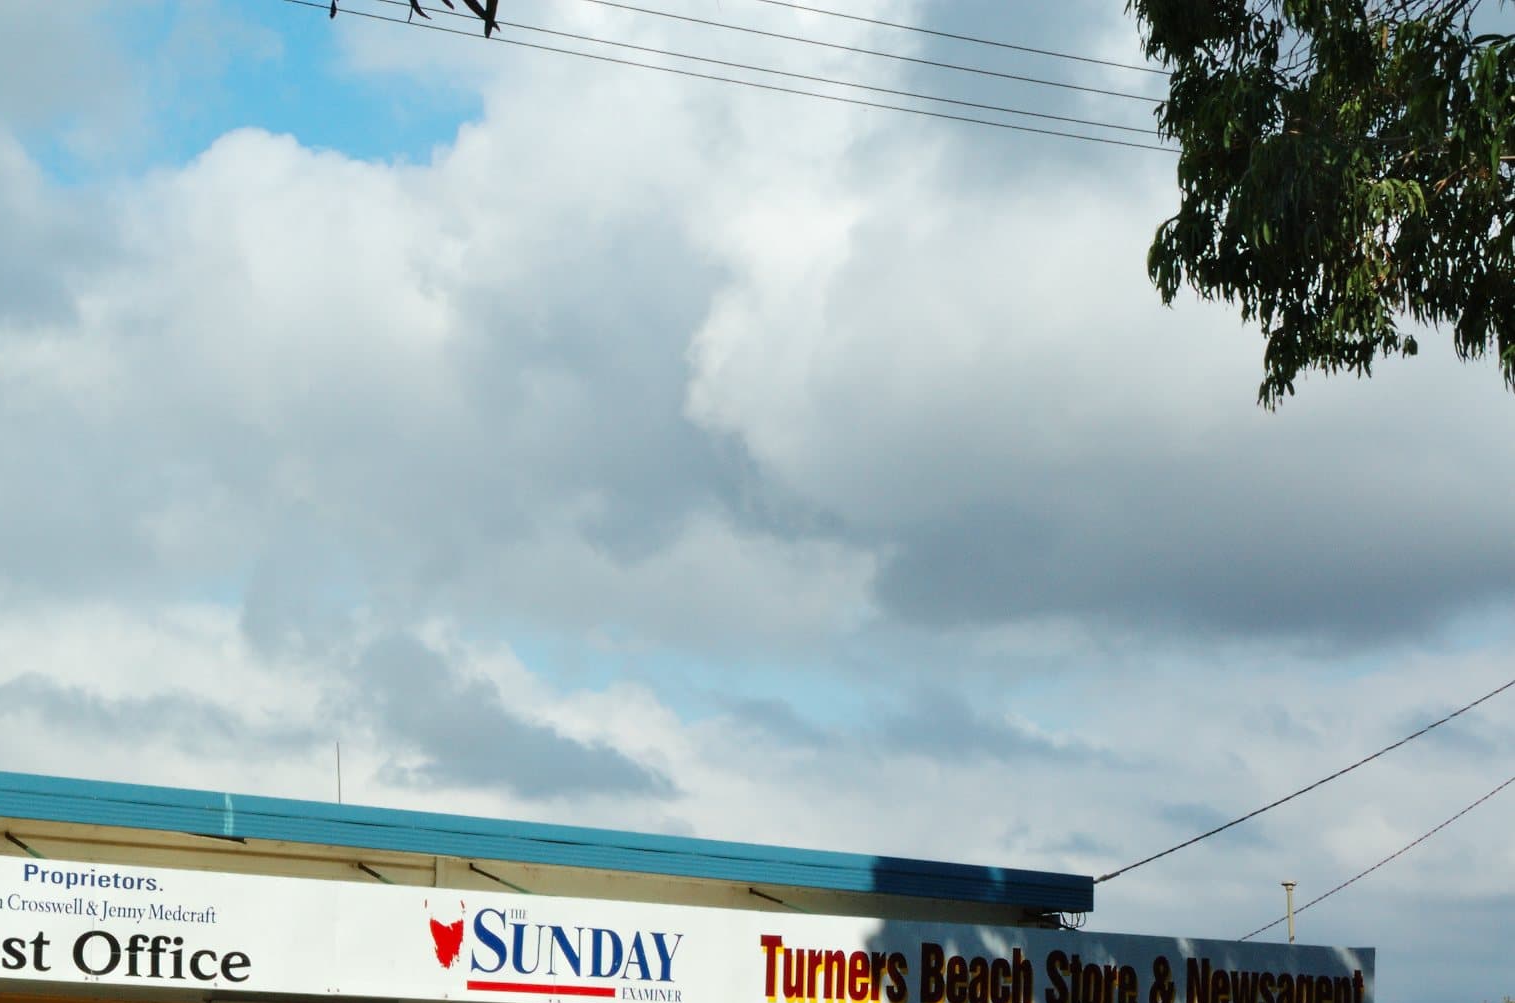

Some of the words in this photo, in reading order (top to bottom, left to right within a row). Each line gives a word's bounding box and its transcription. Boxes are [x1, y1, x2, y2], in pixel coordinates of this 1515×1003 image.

[23, 863, 164, 892] Proprietors.
[7, 893, 83, 917] Crosswell
[86, 900, 98, 916] &
[100, 900, 146, 924] Jenny
[148, 903, 217, 925] Medcraft
[511, 907, 528, 920] THE
[72, 930, 251, 983] Office
[471, 908, 683, 982] SUNDAY
[622, 987, 682, 1003] EXAMINER
